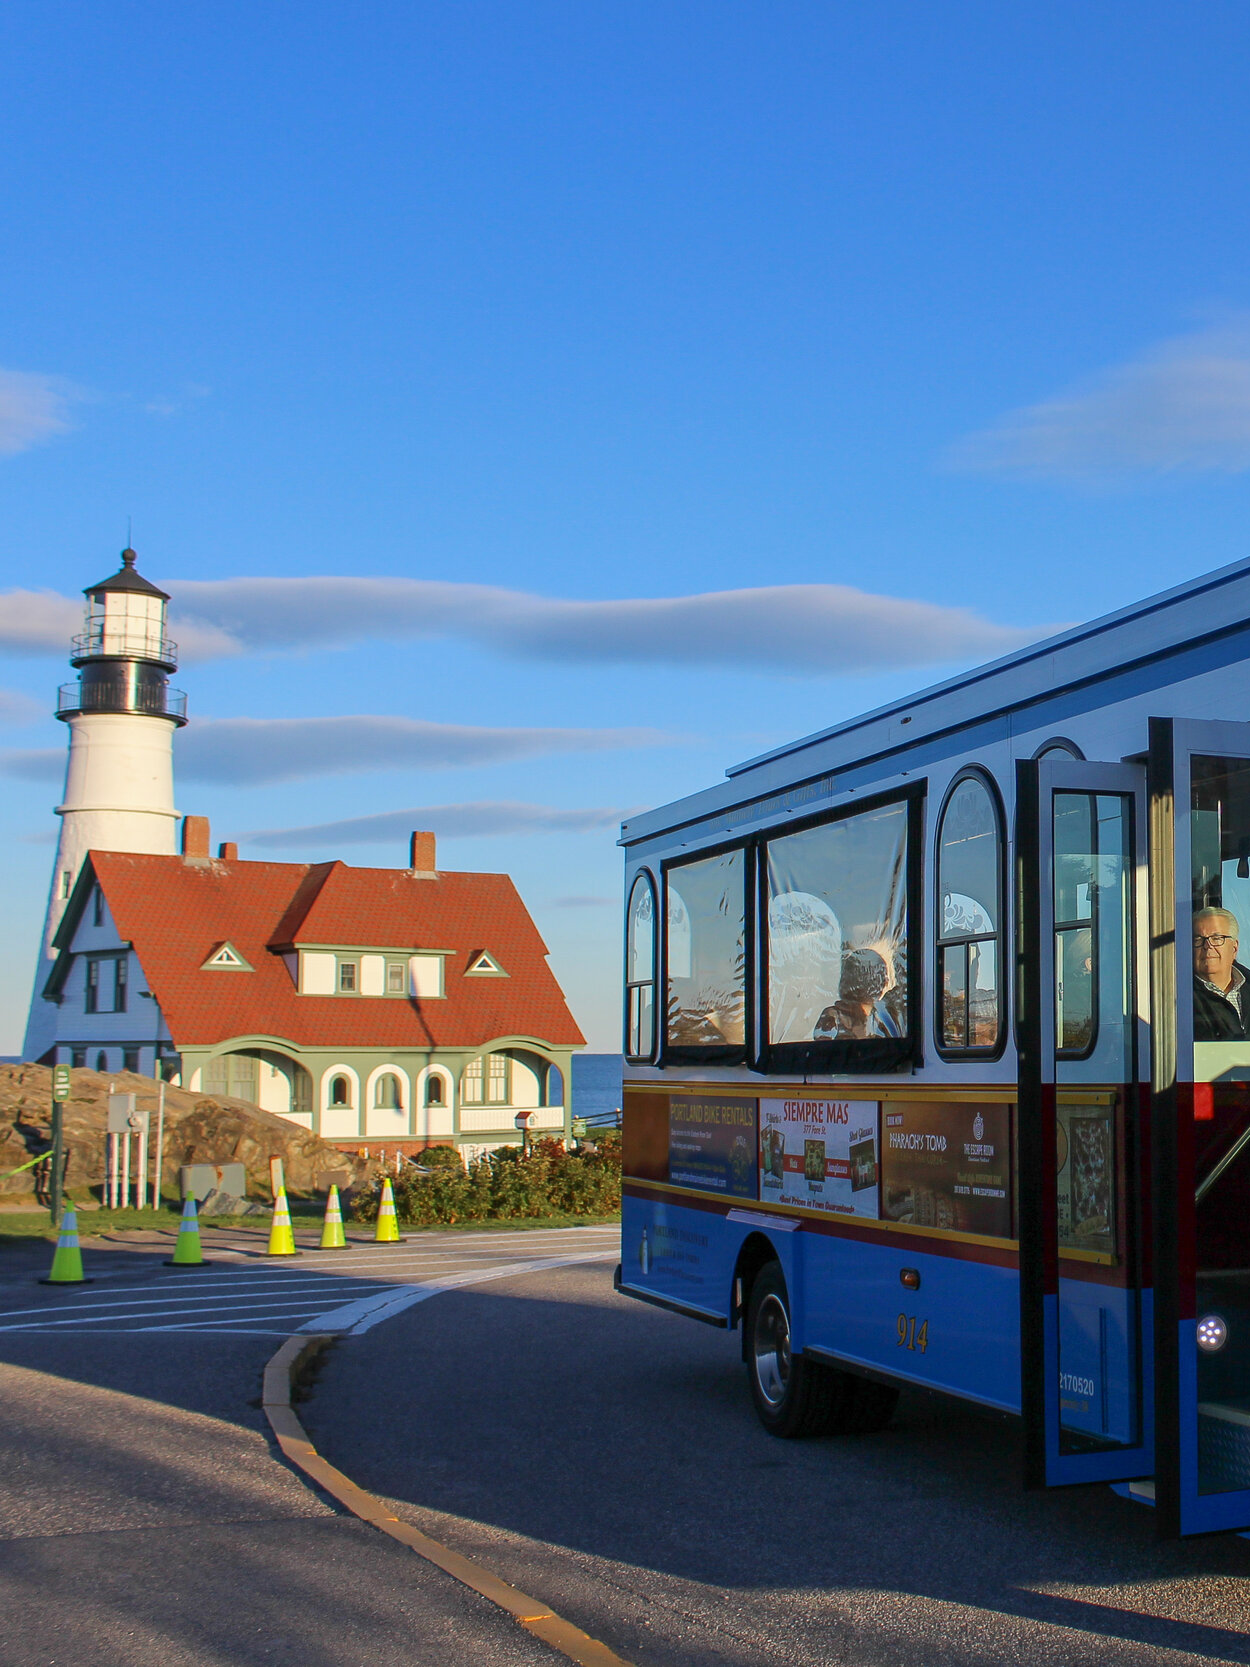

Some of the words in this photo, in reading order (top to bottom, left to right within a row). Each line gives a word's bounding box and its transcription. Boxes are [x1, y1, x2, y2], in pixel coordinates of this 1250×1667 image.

[671, 1103, 703, 1123] PORTLAND
[704, 1105, 720, 1125] BIKE
[722, 1106, 753, 1127] RENTALS
[784, 1101, 823, 1123] SIEMPRE
[827, 1103, 849, 1124] MAS
[803, 1124, 811, 1134] 377
[889, 1132, 924, 1150] PHARAOH'S
[925, 1134, 947, 1151] TOMB
[970, 1144, 983, 1156] ESCAPE
[983, 1145, 994, 1156] ROOM
[897, 1313, 928, 1354] 914
